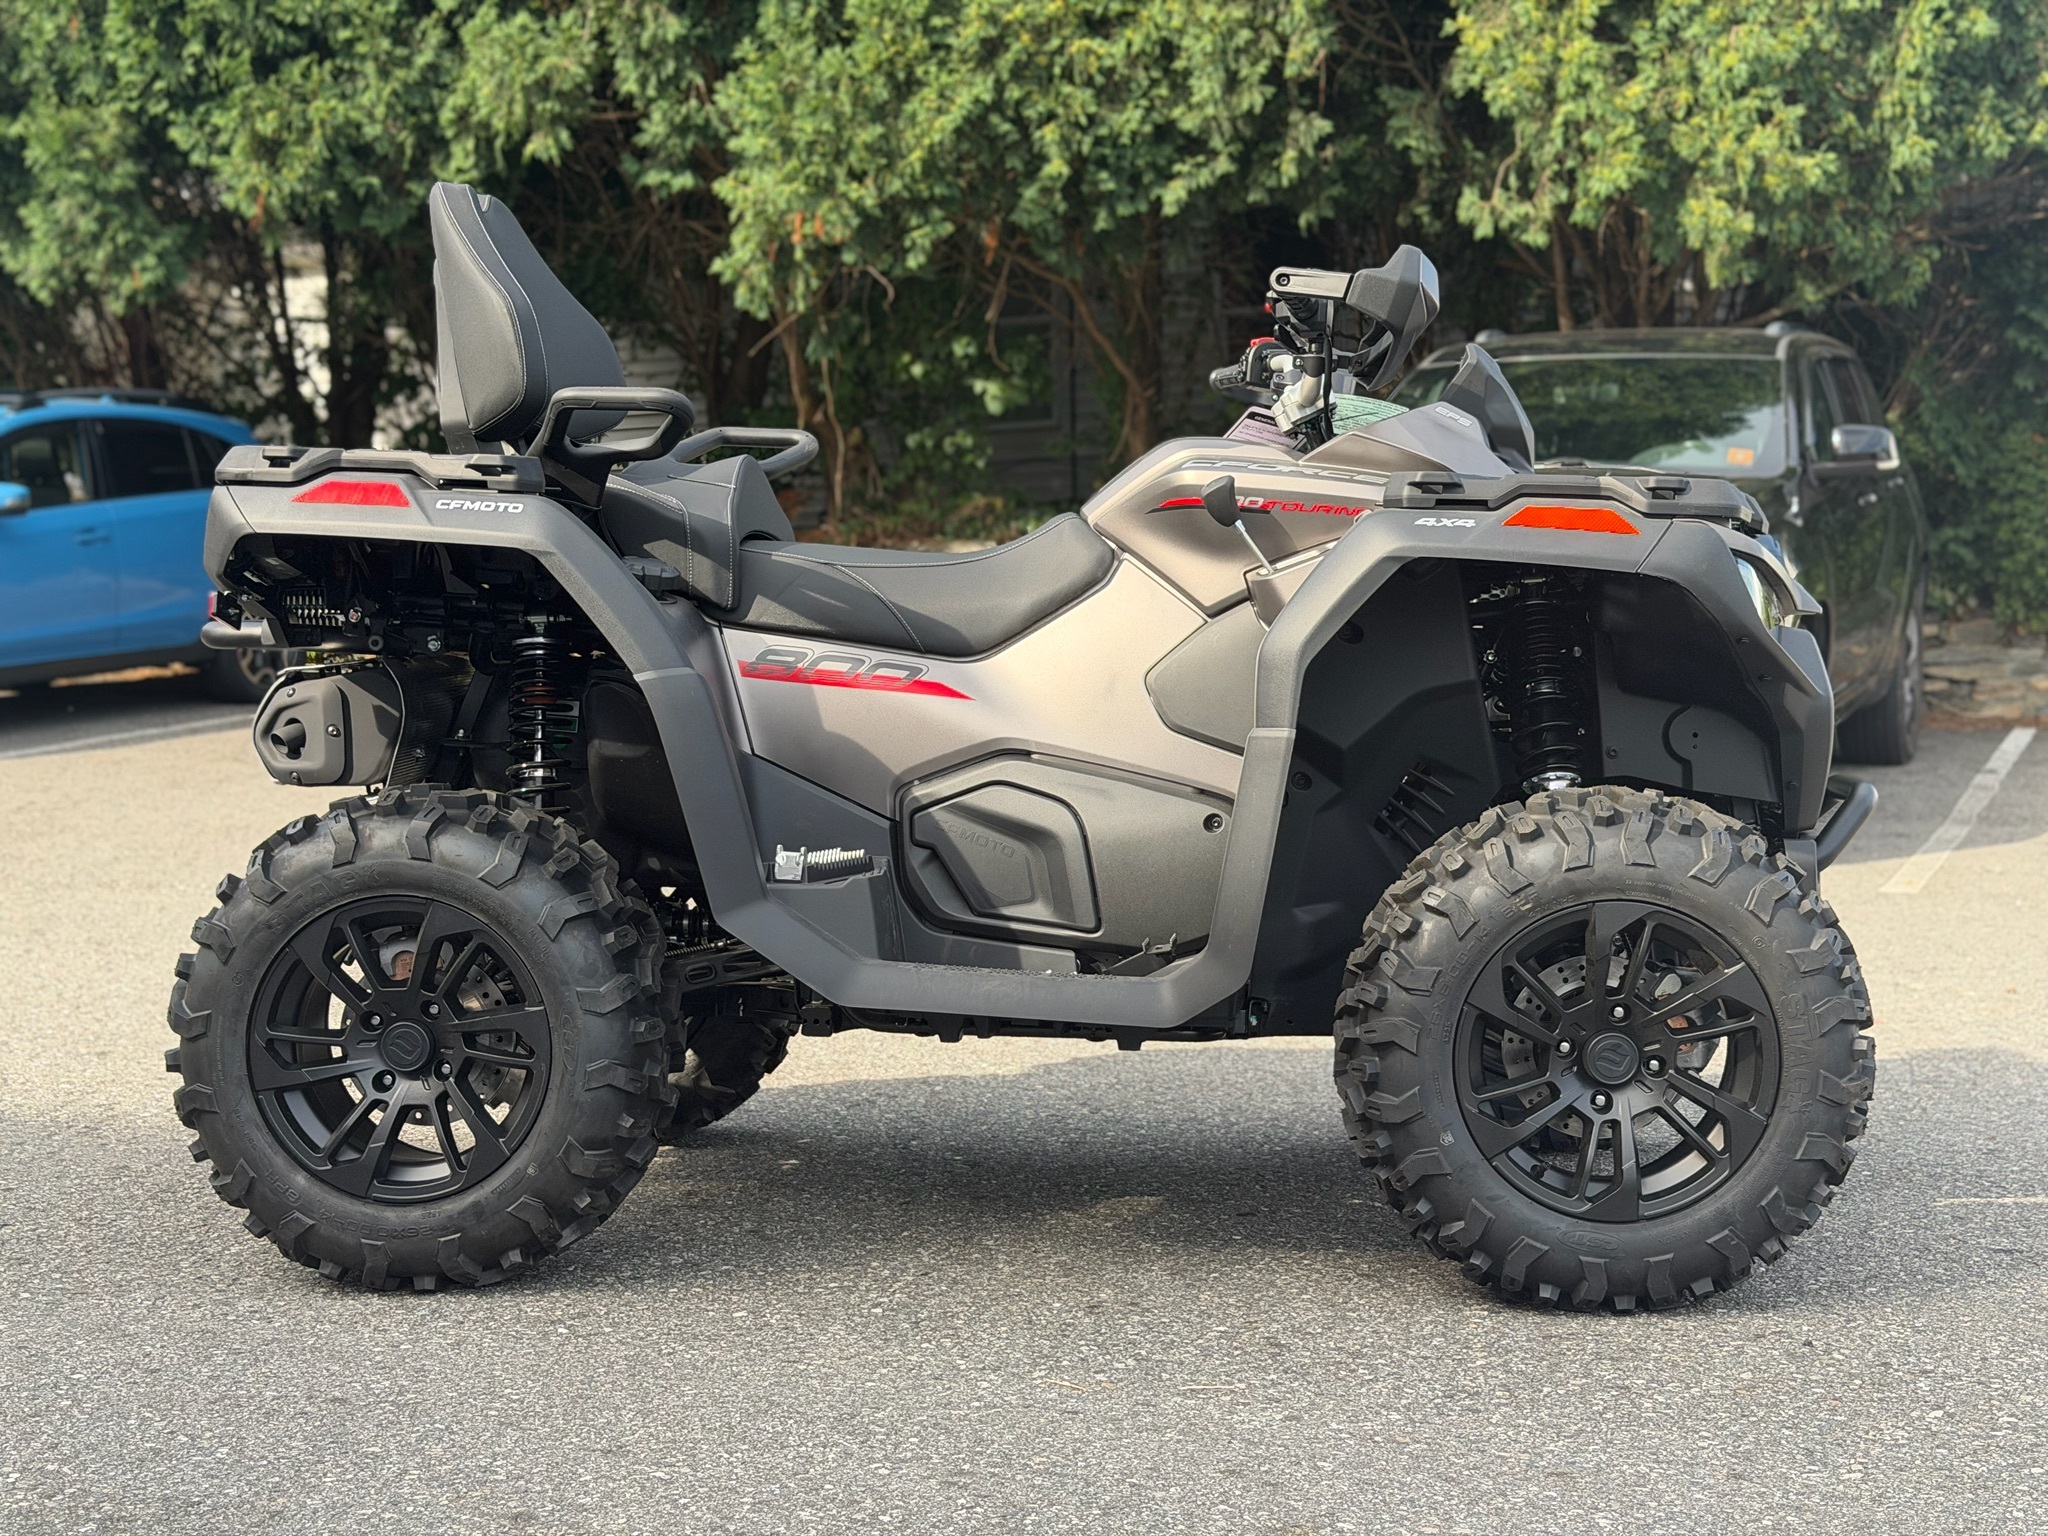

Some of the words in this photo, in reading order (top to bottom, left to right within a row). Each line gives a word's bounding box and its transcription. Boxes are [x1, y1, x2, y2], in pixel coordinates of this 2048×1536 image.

[1434, 406, 1473, 427] EPS
[1180, 459, 1390, 485] CFORCE
[435, 499, 524, 513] CFMOTO
[1265, 499, 1367, 517] TOURIN
[1414, 517, 1476, 528] 4X4
[744, 644, 929, 690] 800
